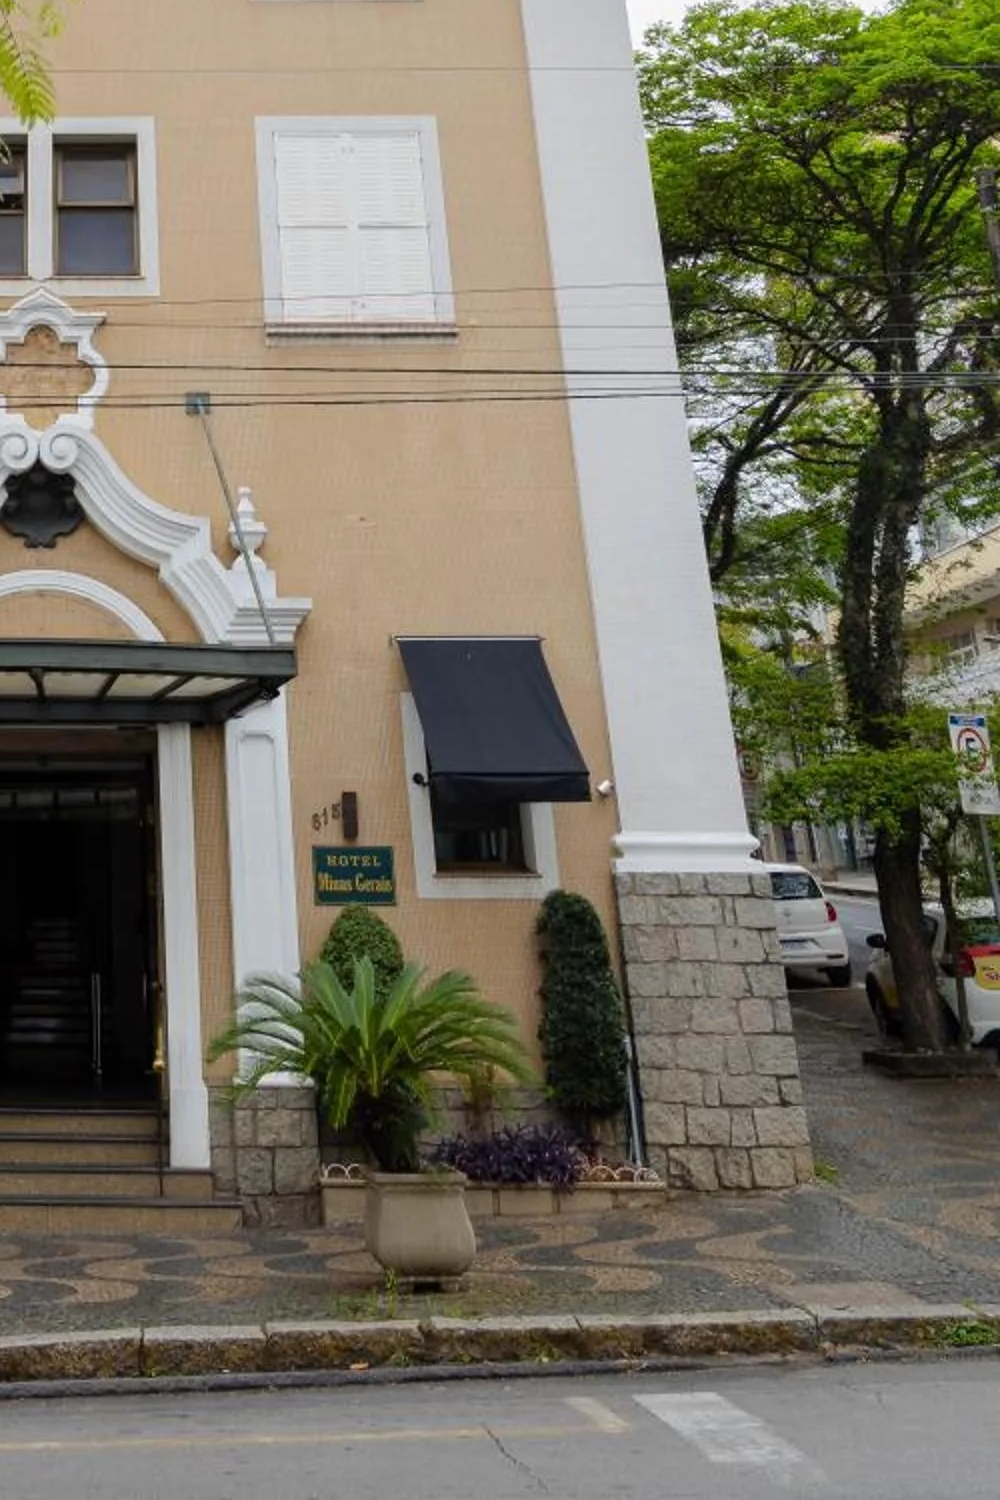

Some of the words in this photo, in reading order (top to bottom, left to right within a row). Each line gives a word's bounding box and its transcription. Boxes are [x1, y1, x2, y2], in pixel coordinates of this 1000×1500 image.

[327, 854, 381, 867] HOTEL
[317, 872, 353, 892] Minas
[355, 872, 393, 892] Gerais
